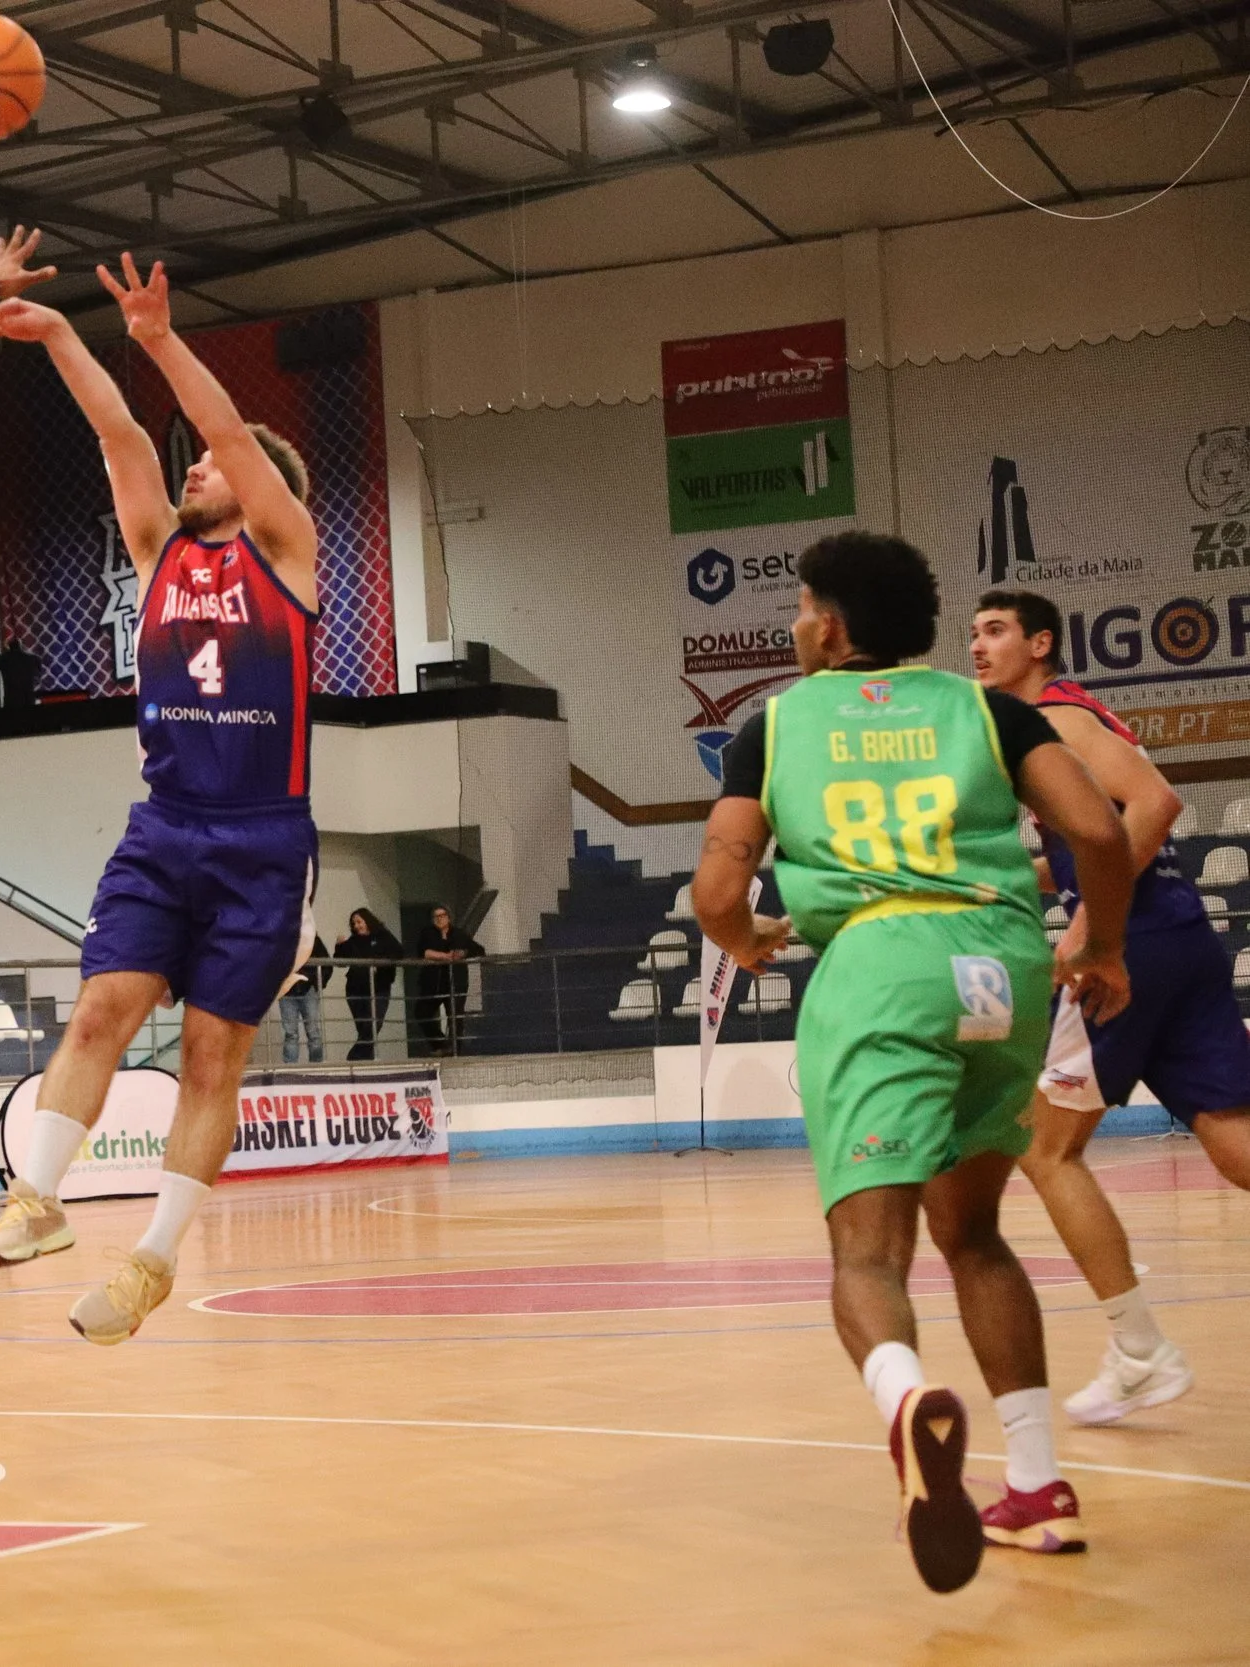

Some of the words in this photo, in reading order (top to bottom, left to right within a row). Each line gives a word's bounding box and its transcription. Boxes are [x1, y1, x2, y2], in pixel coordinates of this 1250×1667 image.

[1016, 563, 1073, 583] Cidade
[1078, 560, 1098, 577] da
[1103, 556, 1143, 574] Maia
[187, 639, 223, 694] 4
[829, 731, 857, 763] G.
[862, 727, 937, 763] BRITO
[822, 774, 959, 875] 88
[323, 1091, 402, 1148] CLUBE
